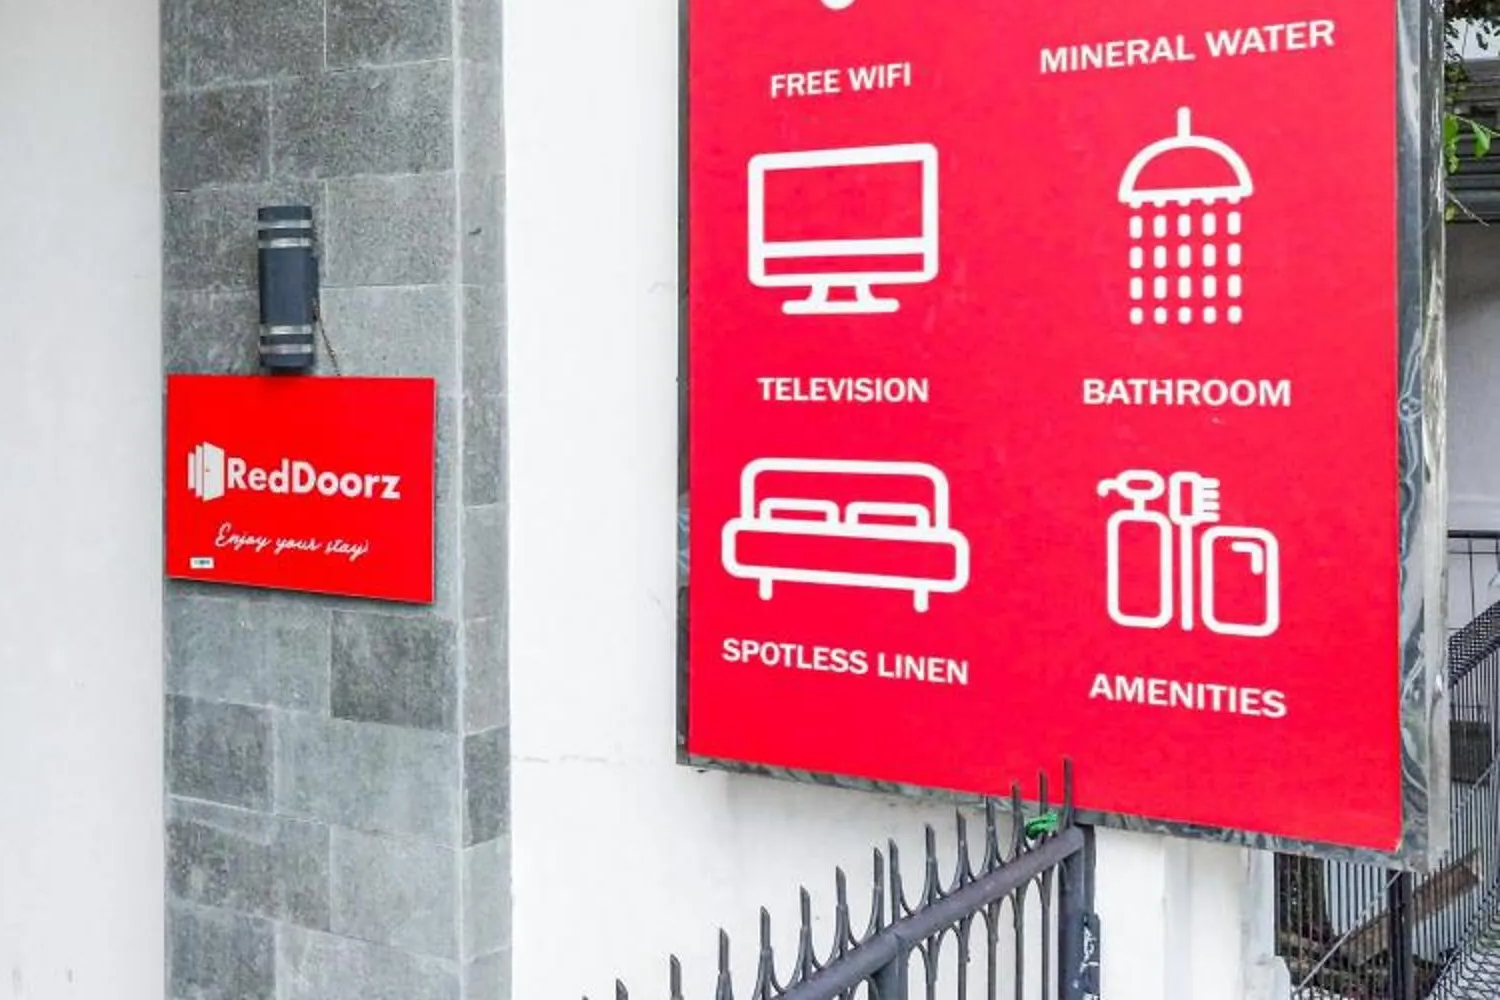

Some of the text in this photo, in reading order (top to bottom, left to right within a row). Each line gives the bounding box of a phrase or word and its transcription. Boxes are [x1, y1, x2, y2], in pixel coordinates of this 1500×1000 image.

[1040, 19, 1335, 73] MINERAL WATER
[771, 62, 911, 98] FREE WIFI
[758, 377, 928, 402] TELEVISION
[1083, 378, 1291, 407] BATHROOM
[228, 457, 400, 499] RedDoorz
[215, 522, 270, 552] Enjoy
[274, 538, 321, 555] your
[723, 638, 968, 685] SPOTLESS LINEN
[1090, 673, 1286, 718] AMENITIES
